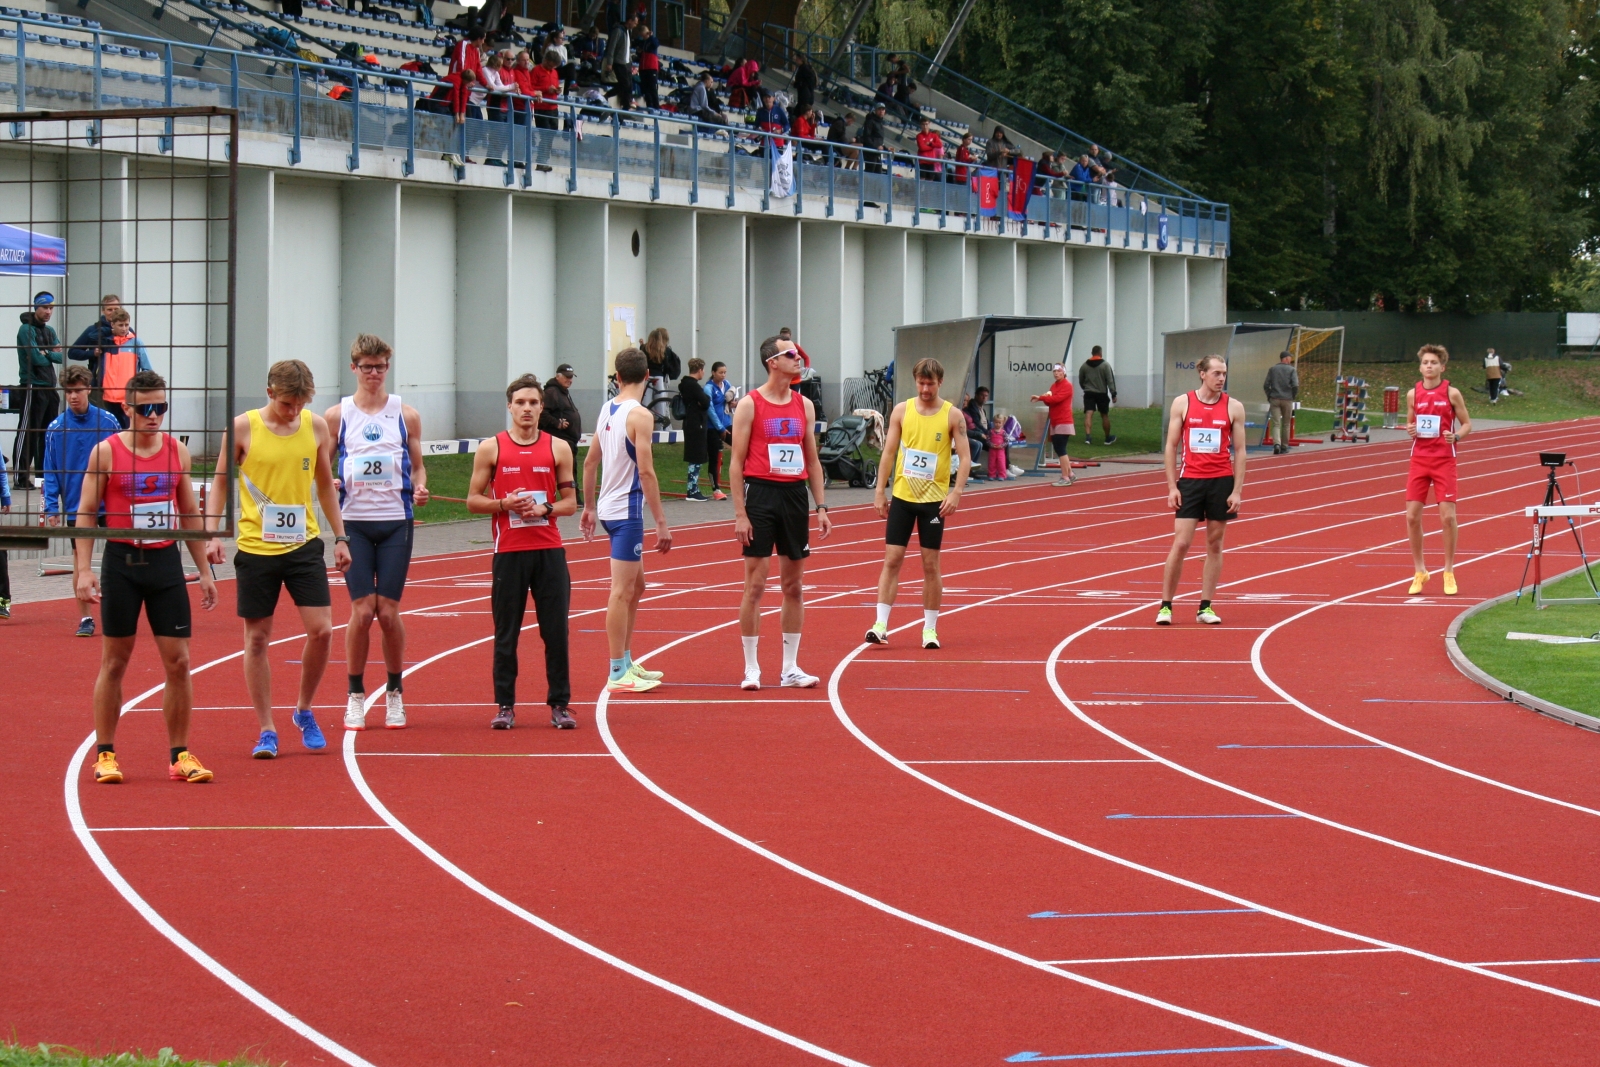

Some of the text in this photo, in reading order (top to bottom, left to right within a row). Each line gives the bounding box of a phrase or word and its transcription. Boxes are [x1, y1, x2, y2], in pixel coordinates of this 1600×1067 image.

[1421, 419, 1432, 429] 23
[1197, 432, 1212, 443] 24
[779, 449, 794, 463] 27
[912, 455, 928, 468] 25
[363, 460, 382, 475] 28
[147, 510, 166, 528] 31
[275, 511, 296, 528] 30
